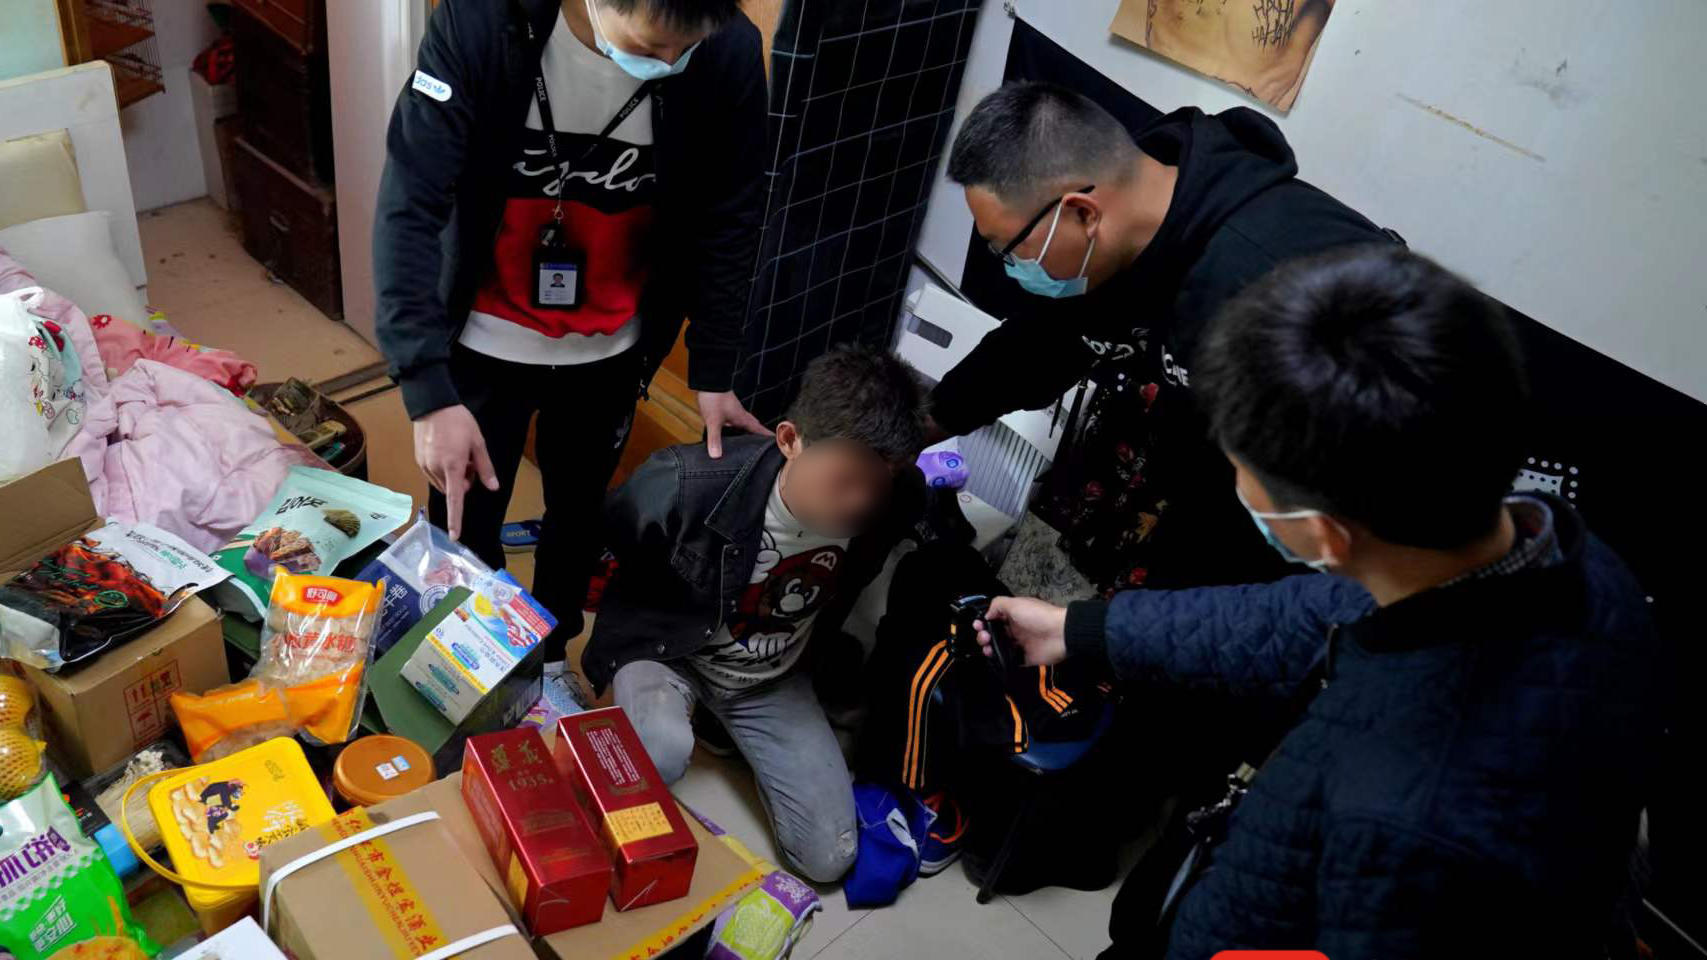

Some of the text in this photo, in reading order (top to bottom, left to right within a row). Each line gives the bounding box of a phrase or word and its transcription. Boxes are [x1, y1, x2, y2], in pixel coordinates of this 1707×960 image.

[535, 76, 547, 102] POLICE
[619, 97, 640, 119] POLICE
[506, 529, 531, 537] SPORT
